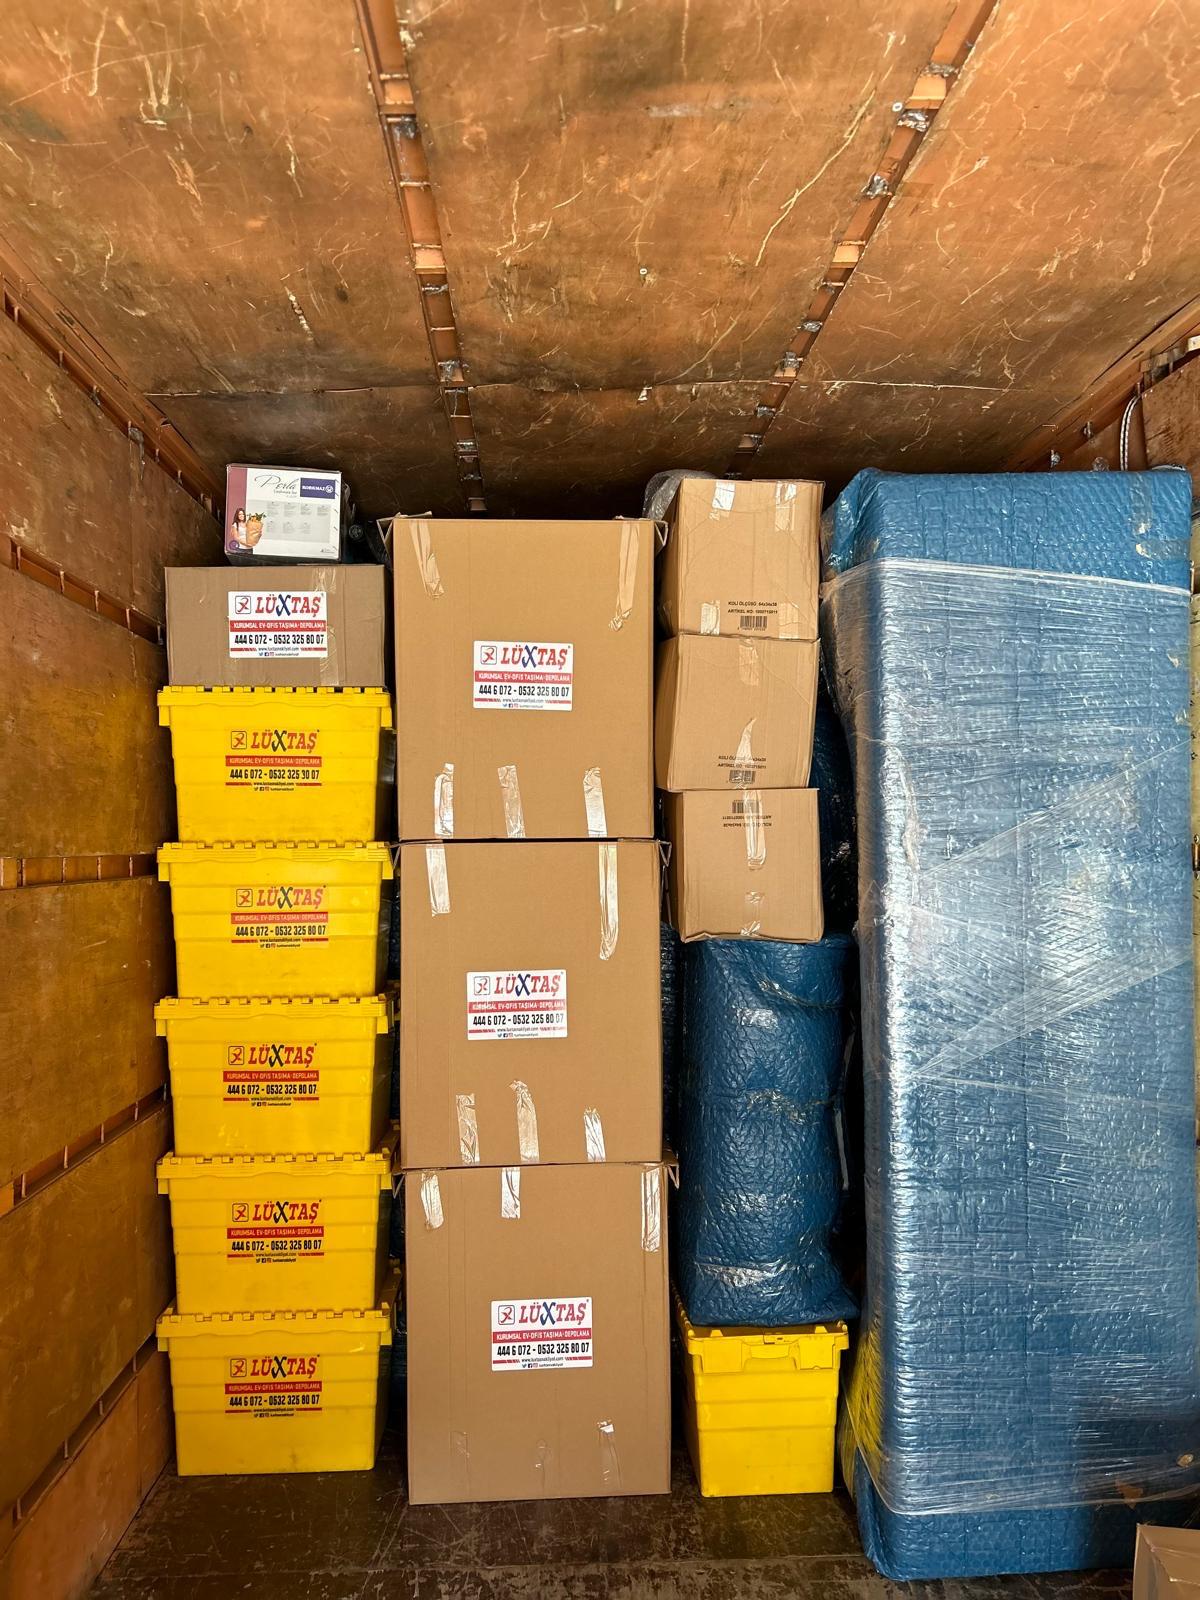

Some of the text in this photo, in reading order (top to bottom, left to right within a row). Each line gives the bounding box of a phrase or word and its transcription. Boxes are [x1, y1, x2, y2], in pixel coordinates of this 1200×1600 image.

[255, 594, 321, 617] LÜXTAŞ
[235, 635, 247, 644] 444
[249, 635, 253, 644] 6
[255, 635, 267, 644] 072
[274, 635, 290, 644] 0532
[292, 635, 304, 644] 325
[306, 635, 314, 644] 80
[316, 635, 324, 644] 07
[501, 644, 567, 670] LÜXTAŞ
[479, 685, 491, 695] 444
[493, 685, 497, 695] 6
[499, 686, 512, 695] 072
[519, 686, 535, 695] 0532
[537, 687, 549, 696] 325
[551, 687, 559, 696] 80
[561, 687, 569, 696] 07
[251, 729, 317, 753] LÜXTAŞ
[230, 769, 242, 779] 444
[244, 769, 248, 779] 6
[250, 769, 262, 779] 072
[269, 769, 285, 779] 0532
[288, 769, 299, 779] 325
[312, 770, 319, 779] 07
[257, 886, 323, 909] LÜXTAŞ
[236, 926, 248, 936] 444
[250, 926, 254, 936] 6
[256, 926, 268, 936] 072
[275, 926, 292, 935] 0532
[294, 926, 306, 935] 325
[308, 926, 316, 935] 80
[318, 925, 326, 935] 07
[494, 973, 560, 996] LÜXTAŞ
[473, 1016, 486, 1025] 444
[488, 1016, 492, 1025] 6
[494, 1015, 506, 1025] 072
[513, 1015, 529, 1024] 0532
[531, 1014, 544, 1024] 325
[546, 1014, 554, 1023] 80
[556, 1013, 564, 1023] 07
[248, 1044, 314, 1068] LÜXTAŞ
[227, 1085, 240, 1095] 444
[241, 1085, 245, 1094] 6
[247, 1085, 259, 1094] 072
[266, 1084, 282, 1094] 0532
[285, 1084, 297, 1094] 325
[299, 1084, 306, 1094] 80
[309, 1084, 316, 1094] 07
[253, 1201, 319, 1224] LÜXTAŞ
[232, 1241, 244, 1251] 444
[246, 1241, 250, 1251] 6
[252, 1241, 264, 1250] 072
[271, 1240, 287, 1250] 0532
[290, 1240, 301, 1250] 325
[304, 1240, 311, 1249] 80
[314, 1240, 321, 1249] 07
[519, 1301, 586, 1326] LÜXTAŞ
[497, 1346, 510, 1356] 444
[512, 1346, 516, 1355] 6
[518, 1345, 531, 1355] 072
[538, 1344, 554, 1354] 0532
[556, 1343, 569, 1353] 325
[571, 1343, 579, 1353] 80
[581, 1342, 589, 1352] 07
[250, 1356, 317, 1378] LÜXTAŞ
[230, 1396, 242, 1406] 444
[244, 1396, 248, 1406] 6
[250, 1396, 262, 1406] 072
[269, 1395, 285, 1405] 0532
[288, 1395, 299, 1405] 325
[302, 1395, 309, 1405] 80
[312, 1395, 319, 1404] 07
